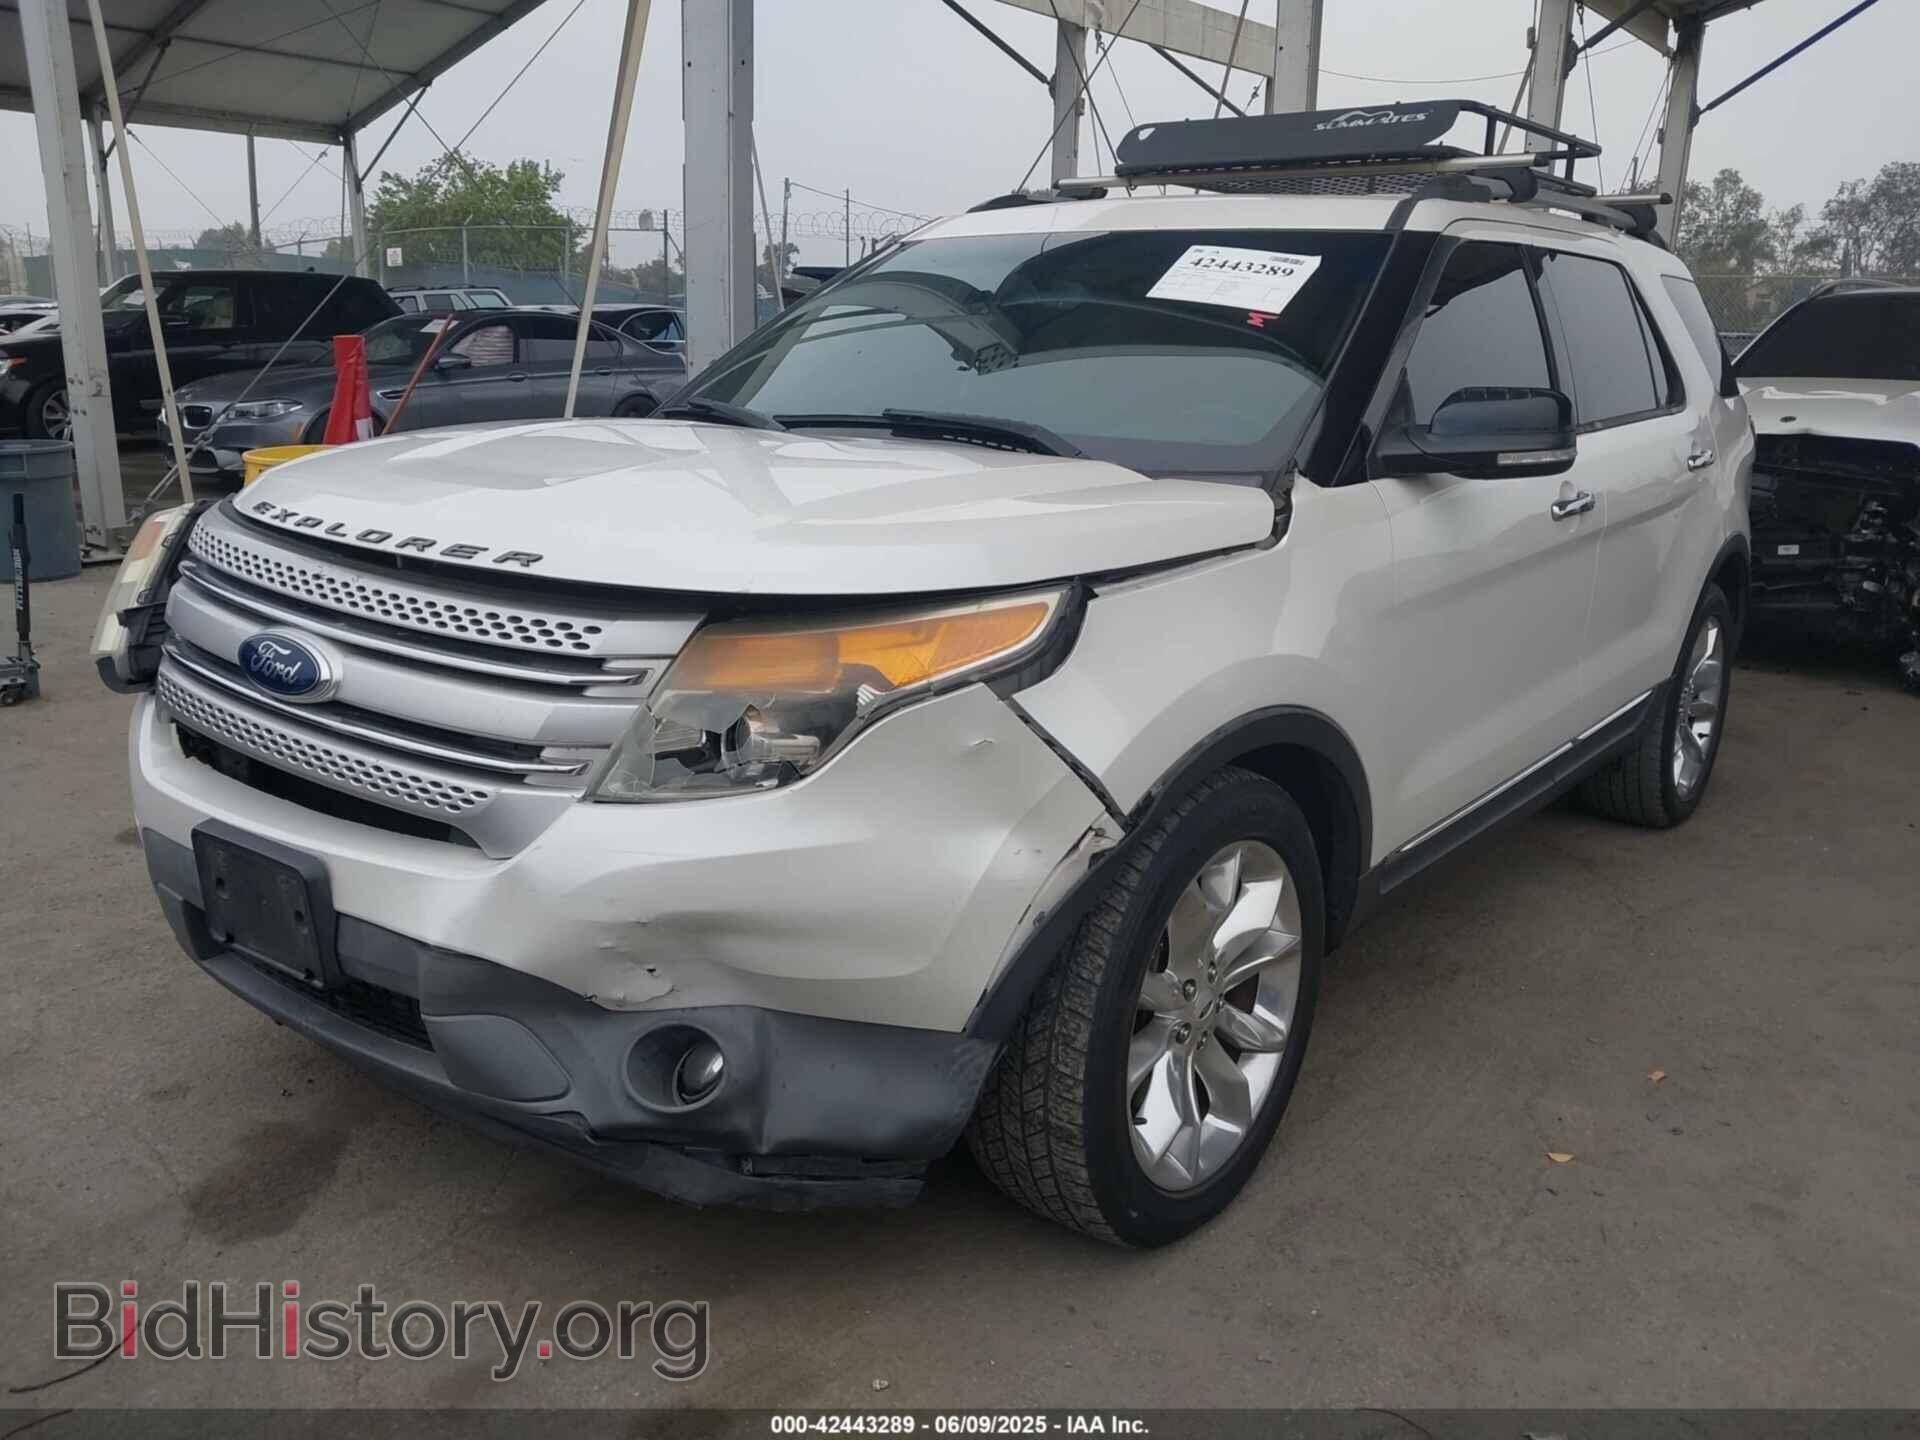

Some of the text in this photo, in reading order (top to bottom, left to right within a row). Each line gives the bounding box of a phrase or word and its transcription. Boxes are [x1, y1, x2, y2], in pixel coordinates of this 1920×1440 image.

[1190, 256, 1295, 278] 42443289
[252, 501, 545, 567] EXPLORER
[249, 640, 303, 684] Ford
